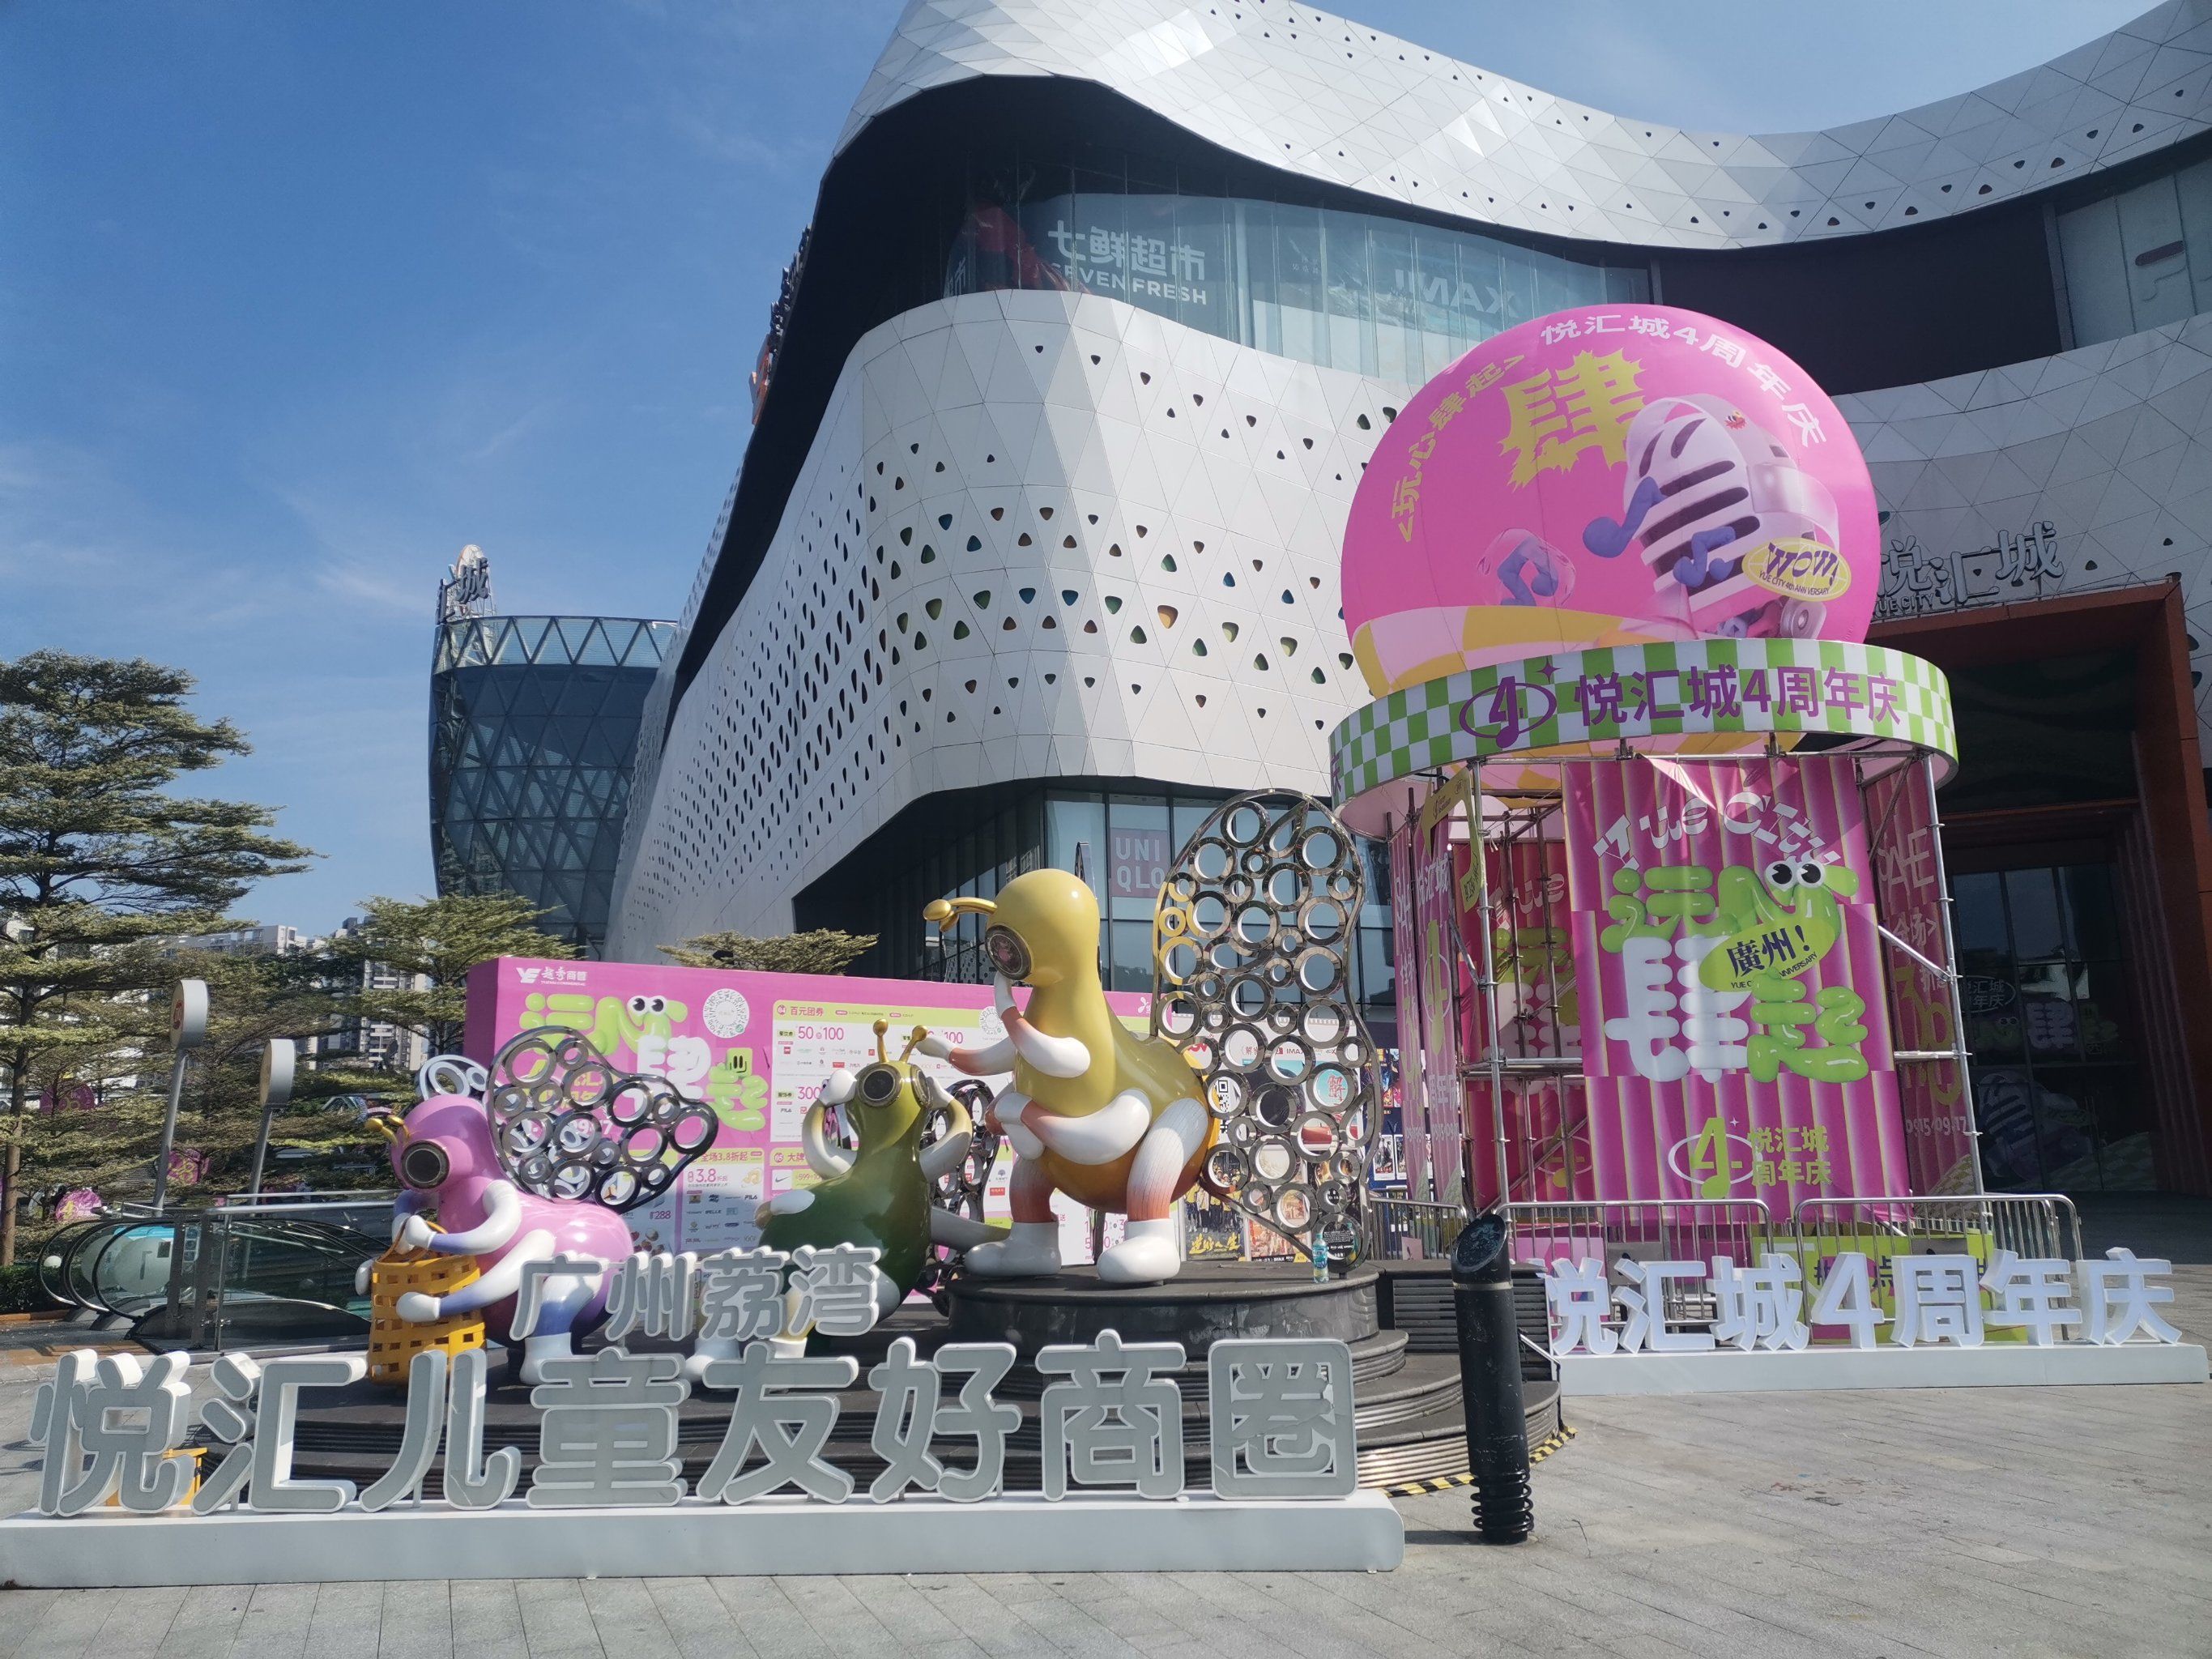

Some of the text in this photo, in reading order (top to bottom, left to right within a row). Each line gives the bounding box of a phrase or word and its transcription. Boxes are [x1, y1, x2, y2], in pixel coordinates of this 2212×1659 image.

[1047, 220, 1206, 281] 七鲜超市
[1051, 262, 1208, 305] SEVEN FRESH
[1395, 269, 1520, 318] IMAX
[1540, 314, 1827, 447] 悦汇城4周年庆
[1766, 542, 1840, 586] WOW!
[1771, 578, 1785, 588] CITY
[1877, 520, 2065, 605] 悦汇城
[1900, 591, 1935, 612] CITY
[1574, 663, 1900, 726] 悦汇城4周年庆
[1115, 837, 1161, 863] UNI
[790, 1006, 824, 1017] 百元团券
[798, 1026, 844, 1041] 50 100
[1747, 1124, 1831, 1154] 悦汇城
[1750, 1158, 1833, 1187] 周年庆
[509, 1242, 883, 1345] 广州荔湾
[1543, 1247, 2182, 1356] 悦汇城4周年庆
[27, 1328, 1359, 1518] 悦汇儿童友好商圈
